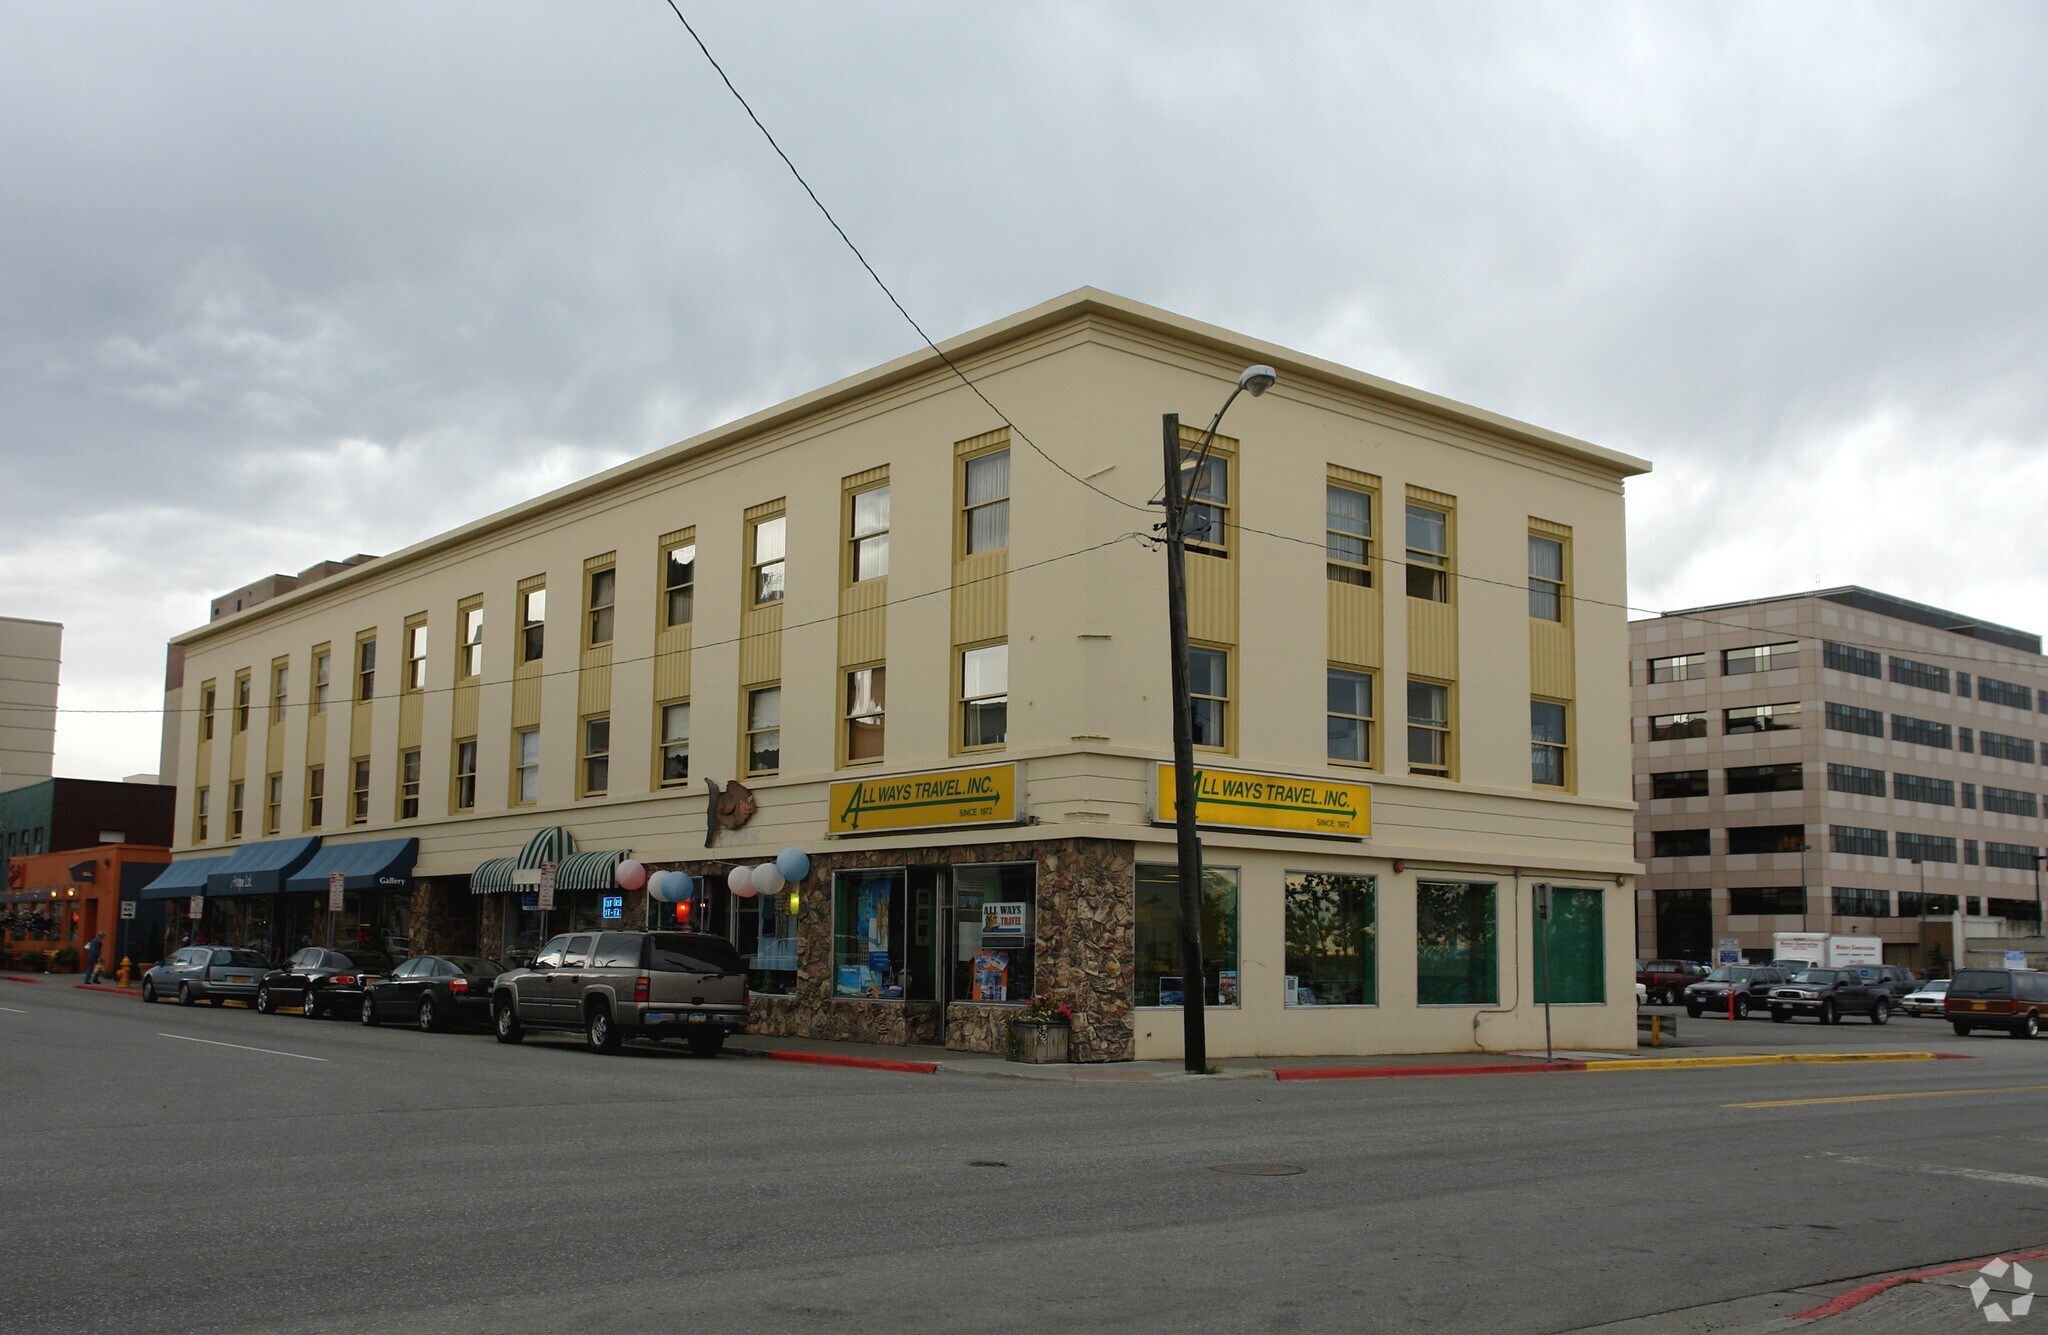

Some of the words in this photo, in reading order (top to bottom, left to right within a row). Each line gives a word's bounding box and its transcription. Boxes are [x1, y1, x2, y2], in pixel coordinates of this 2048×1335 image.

[1222, 779, 1263, 799] WAYS
[841, 783, 876, 830] ALL
[878, 783, 912, 802] WAYS
[959, 808, 977, 818] SINCE
[980, 807, 993, 816] 1972
[1316, 818, 1335, 828] SINCE
[1337, 820, 1351, 829] 1972
[379, 876, 406, 887] Gallery
[983, 906, 999, 916] ALL
[999, 905, 1022, 915] WAYS
[1000, 916, 1022, 926] TRAVEL
